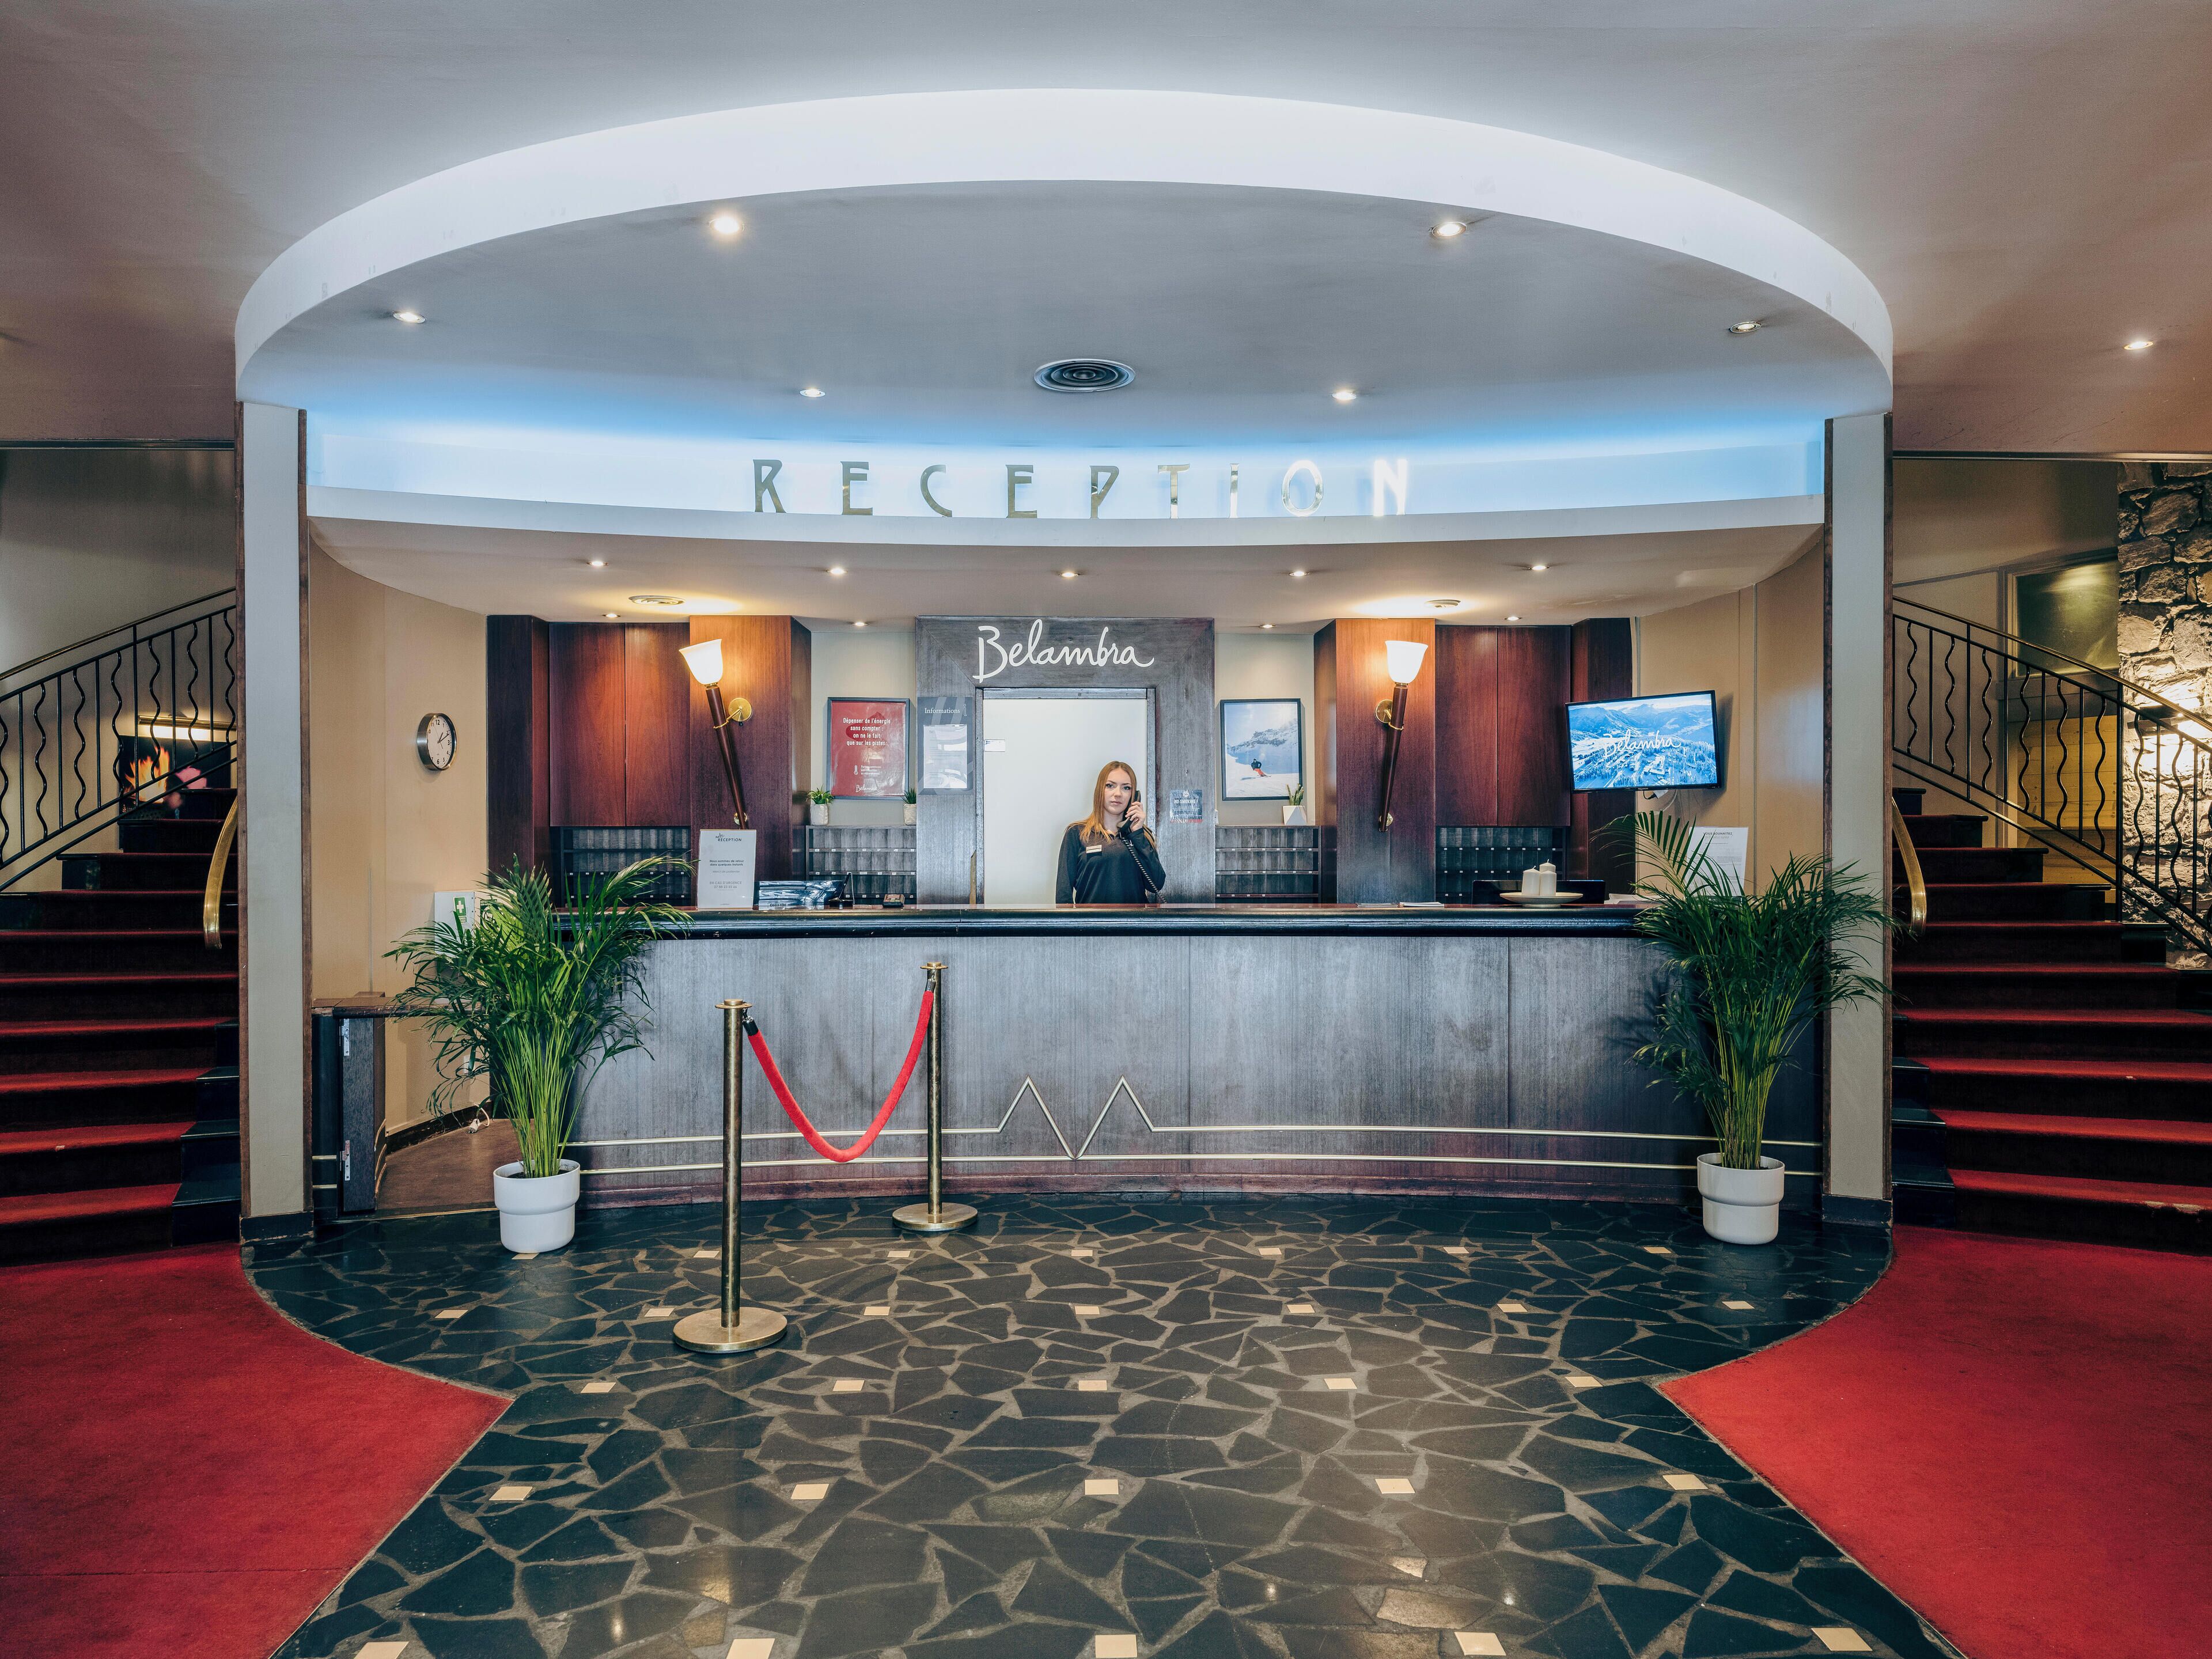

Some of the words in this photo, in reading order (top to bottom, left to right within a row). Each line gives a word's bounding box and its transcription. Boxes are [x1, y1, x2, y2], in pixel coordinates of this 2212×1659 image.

[752, 459, 1408, 520] RECEPTION
[972, 619, 1154, 684] Belambra
[1603, 729, 1681, 759] Belambra
